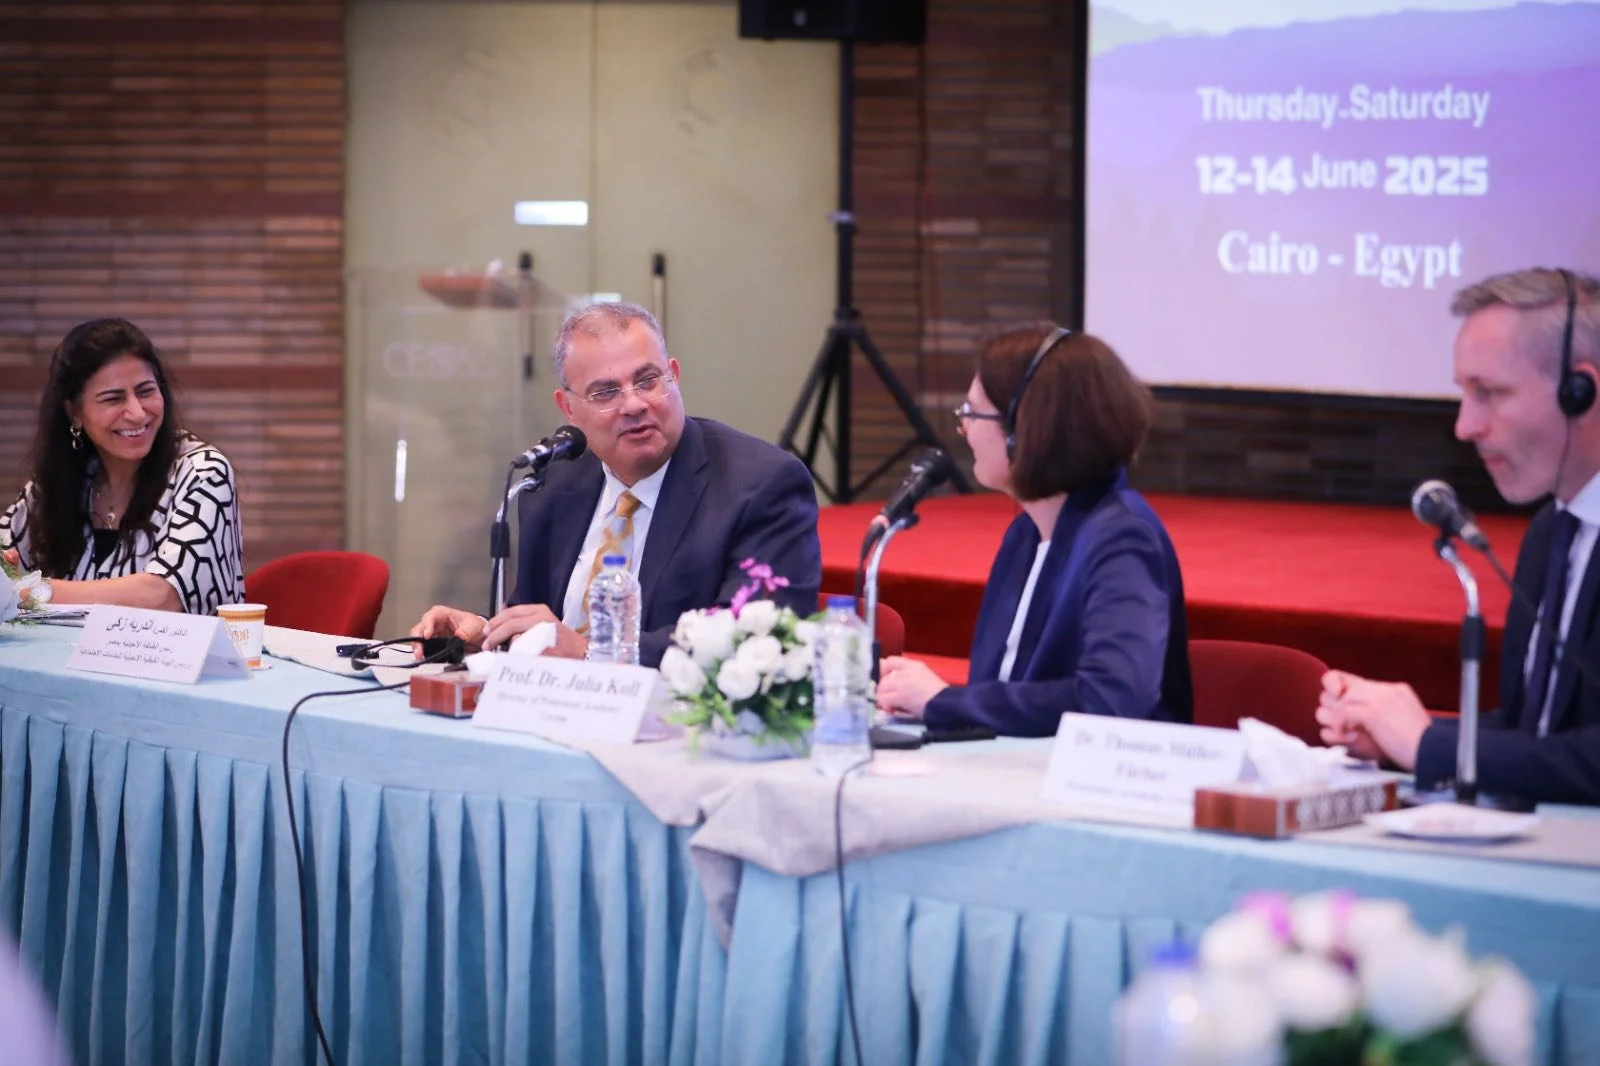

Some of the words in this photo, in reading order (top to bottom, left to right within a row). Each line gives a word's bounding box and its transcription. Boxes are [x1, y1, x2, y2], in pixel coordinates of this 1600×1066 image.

[1195, 154, 1297, 195] 12-14
[1302, 151, 1379, 189] June
[1384, 154, 1489, 195] 2025
[1217, 229, 1320, 275] Cairo
[1353, 231, 1463, 290] Egypt
[498, 665, 534, 686] Prof.
[538, 669, 560, 688] Dr.
[564, 673, 603, 693] Julia
[606, 677, 643, 697] Koll
